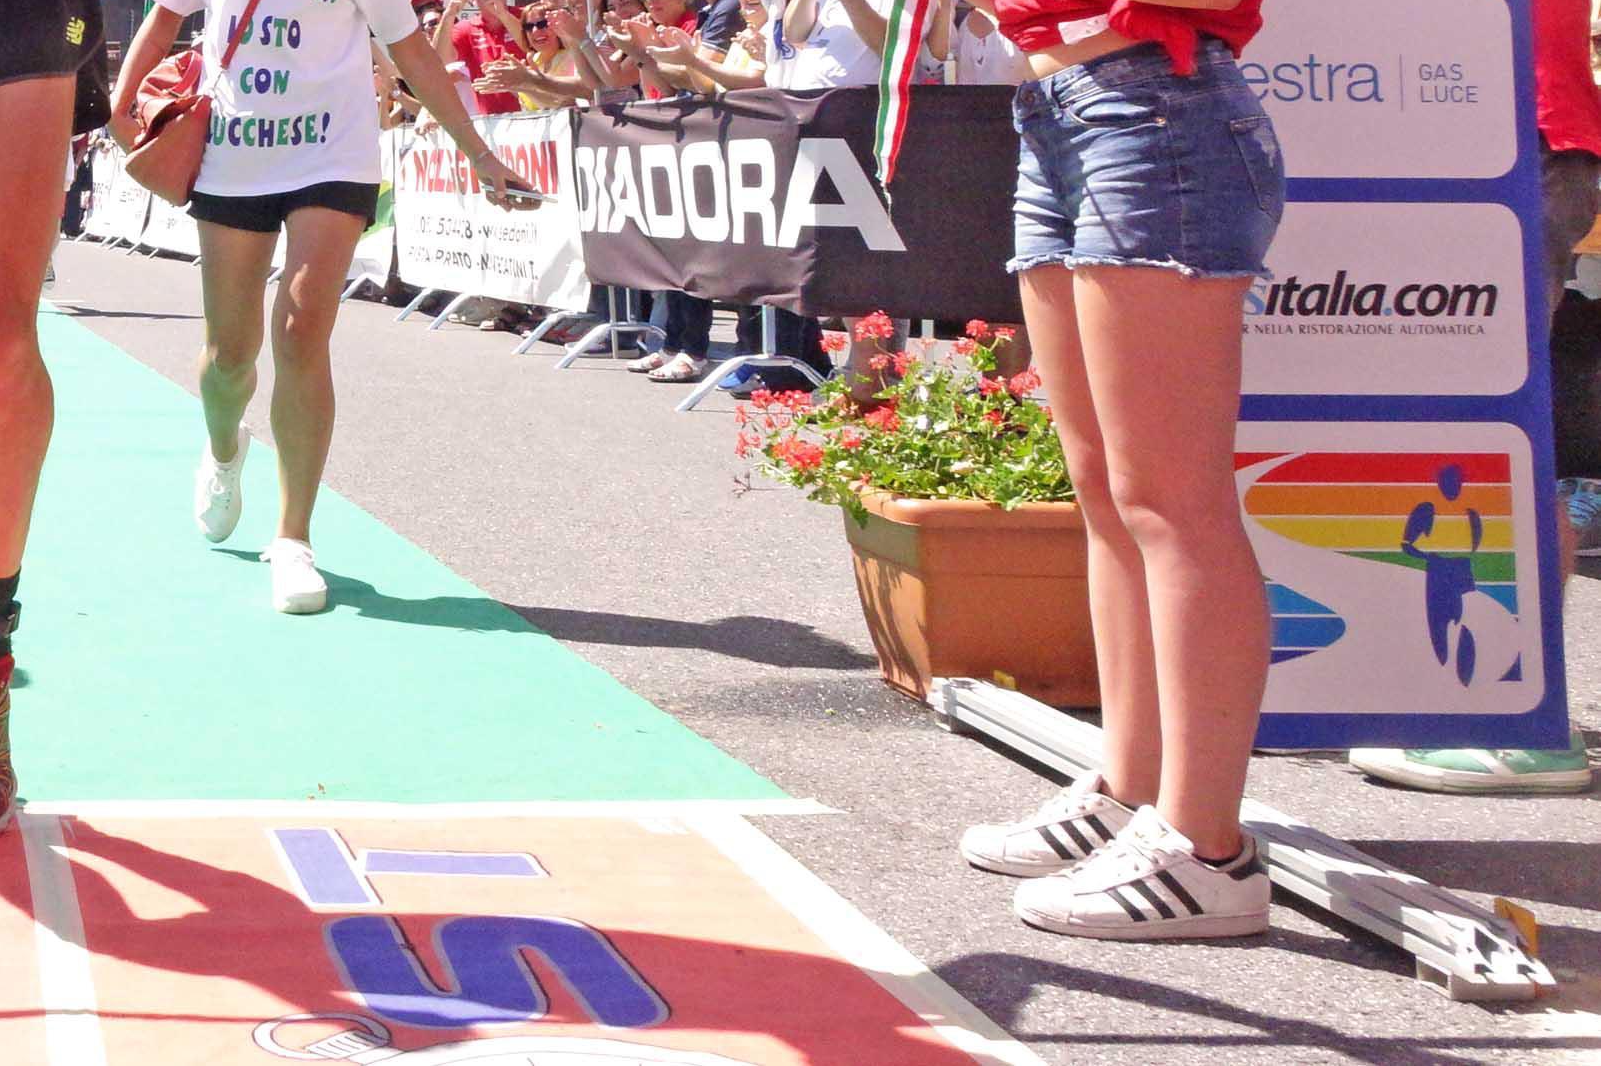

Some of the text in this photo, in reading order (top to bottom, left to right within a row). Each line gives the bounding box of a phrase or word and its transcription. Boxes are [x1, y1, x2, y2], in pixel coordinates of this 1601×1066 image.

[259, 15, 301, 49] STO
[240, 67, 291, 94] CON
[1418, 63, 1463, 81] GAS
[1420, 85, 1479, 103] LUCE
[206, 112, 331, 148] UCCHESE!
[576, 136, 908, 252] DIADORA
[1243, 270, 1498, 317] sitalia.com
[1254, 323, 1294, 335] NELLA
[1299, 323, 1394, 335] RISTORAZIONE
[1399, 323, 1486, 335] AUTOMATICA
